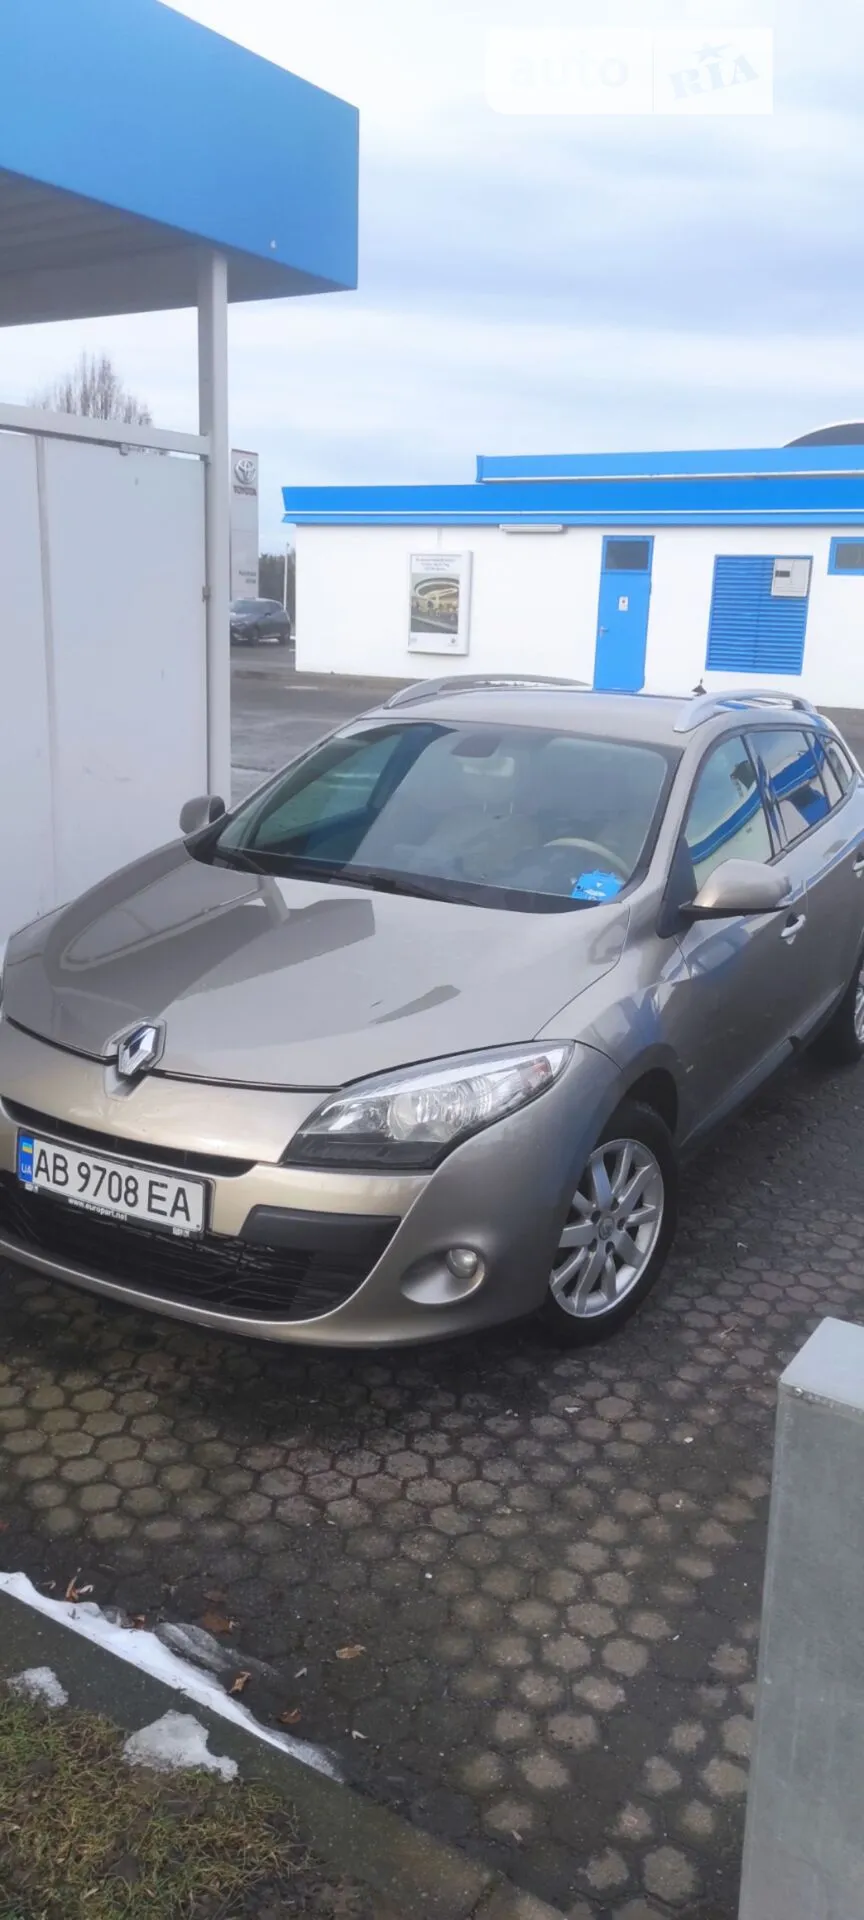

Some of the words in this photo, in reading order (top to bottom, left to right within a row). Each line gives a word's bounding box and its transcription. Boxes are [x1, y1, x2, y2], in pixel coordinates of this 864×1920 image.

[233, 485, 257, 497] TOYOTA
[21, 1163, 32, 1175] UA
[35, 1149, 69, 1186] AB
[77, 1161, 139, 1208] 9708
[147, 1180, 190, 1222] EA
